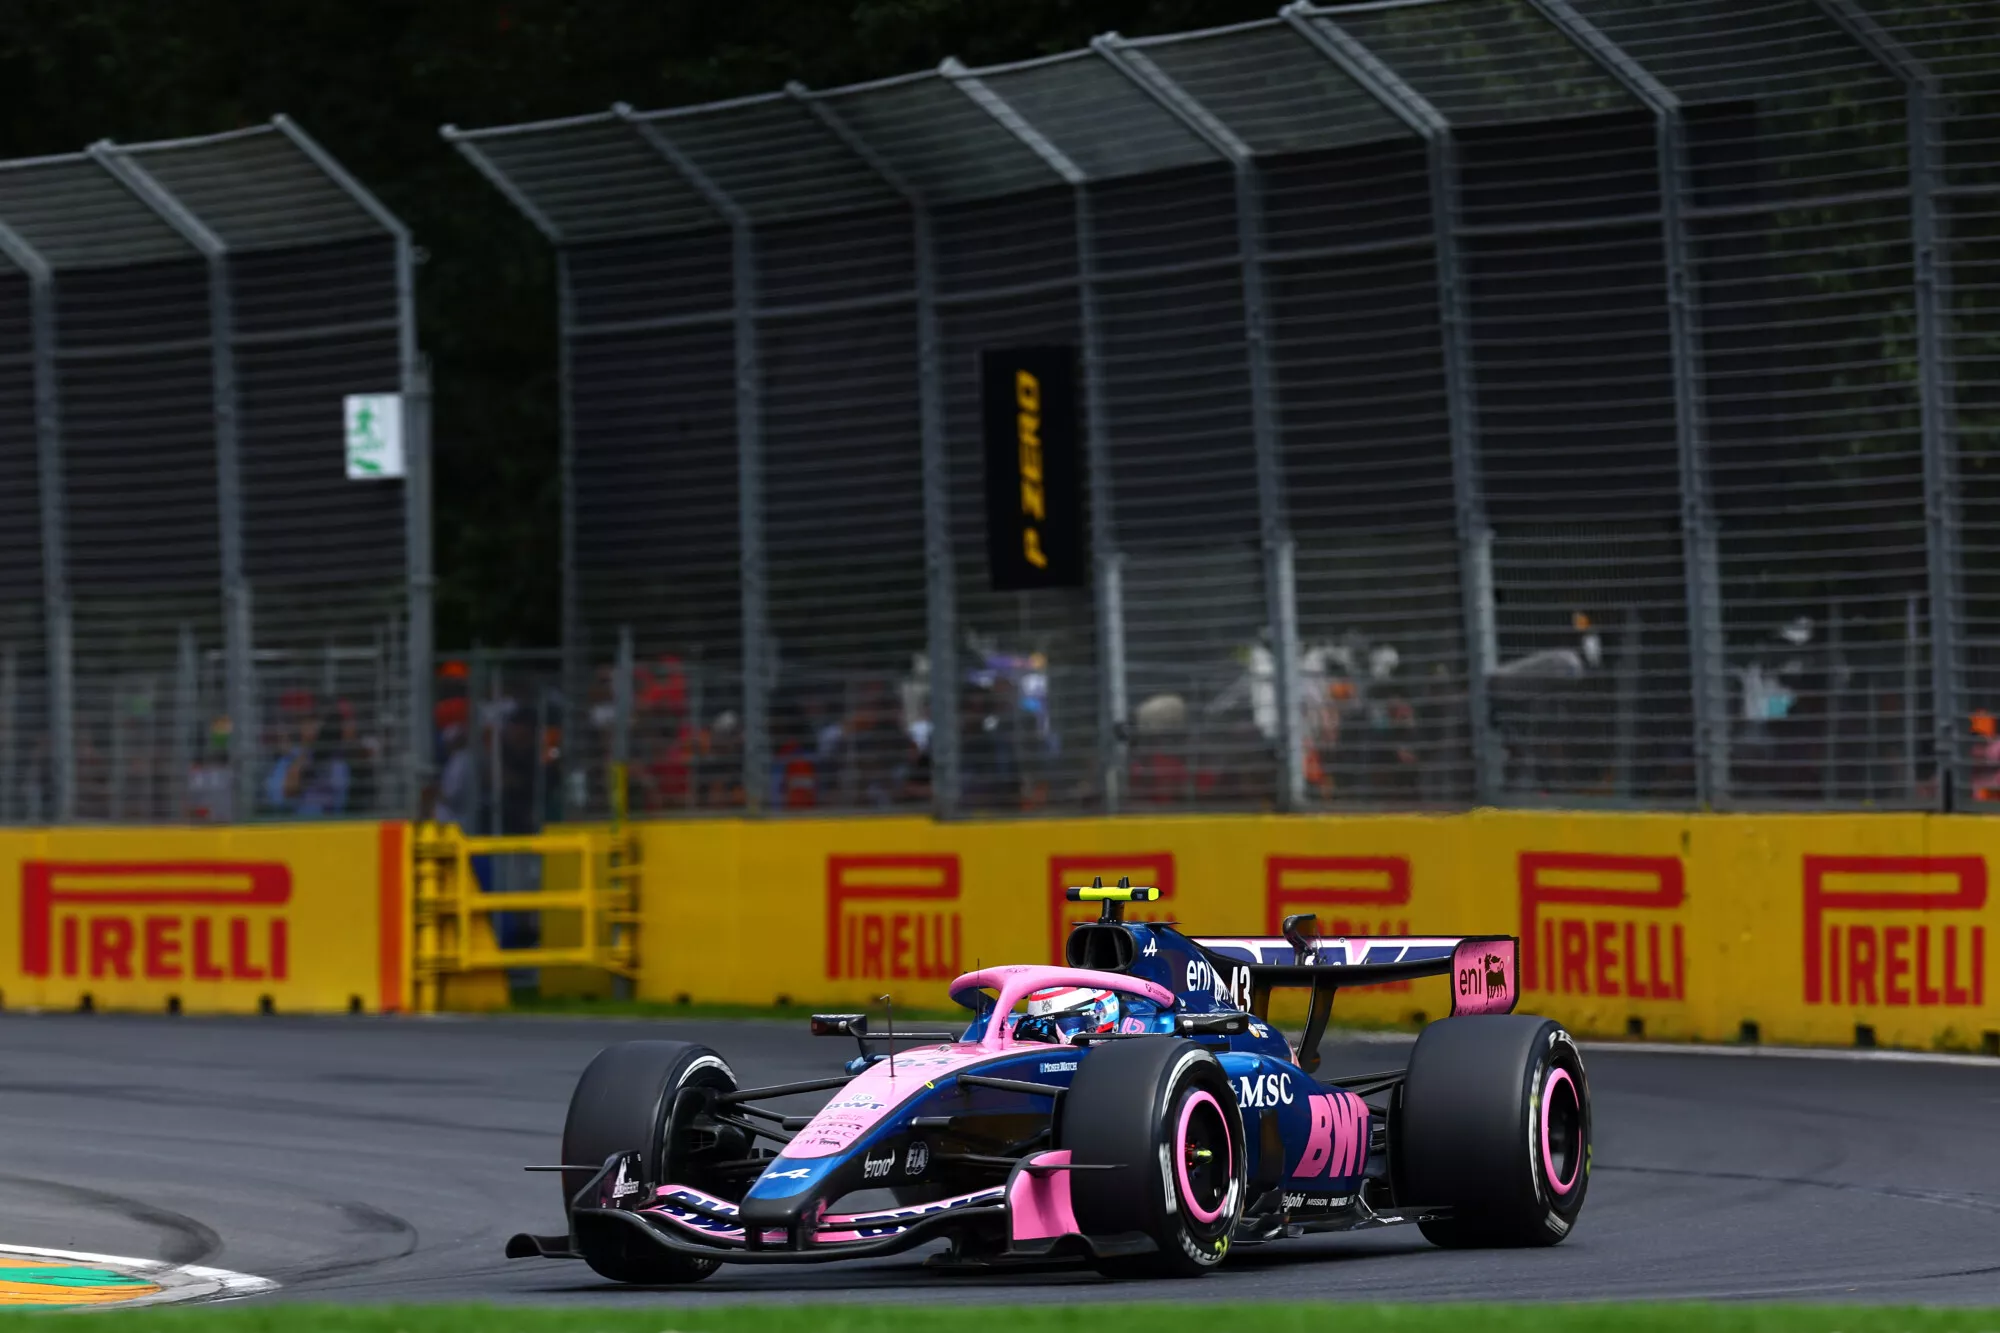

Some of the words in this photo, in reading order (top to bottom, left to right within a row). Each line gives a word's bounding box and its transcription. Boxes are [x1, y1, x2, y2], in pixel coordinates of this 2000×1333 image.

[1016, 370, 1045, 520] ZERO
[1024, 528, 1047, 568] P
[20, 860, 292, 981] PIRELLI
[826, 853, 961, 981] PIRELLI
[1518, 851, 1685, 1000] PIRELLI
[1803, 854, 1988, 1006] PIRELLI
[1186, 960, 1211, 992] eni
[1459, 958, 1482, 996] eni
[1239, 1073, 1294, 1108] MSC
[816, 1129, 855, 1138] MSC
[1292, 1091, 1370, 1178] BWT
[906, 1149, 926, 1167] FIA
[1306, 1198, 1328, 1206] MISSION
